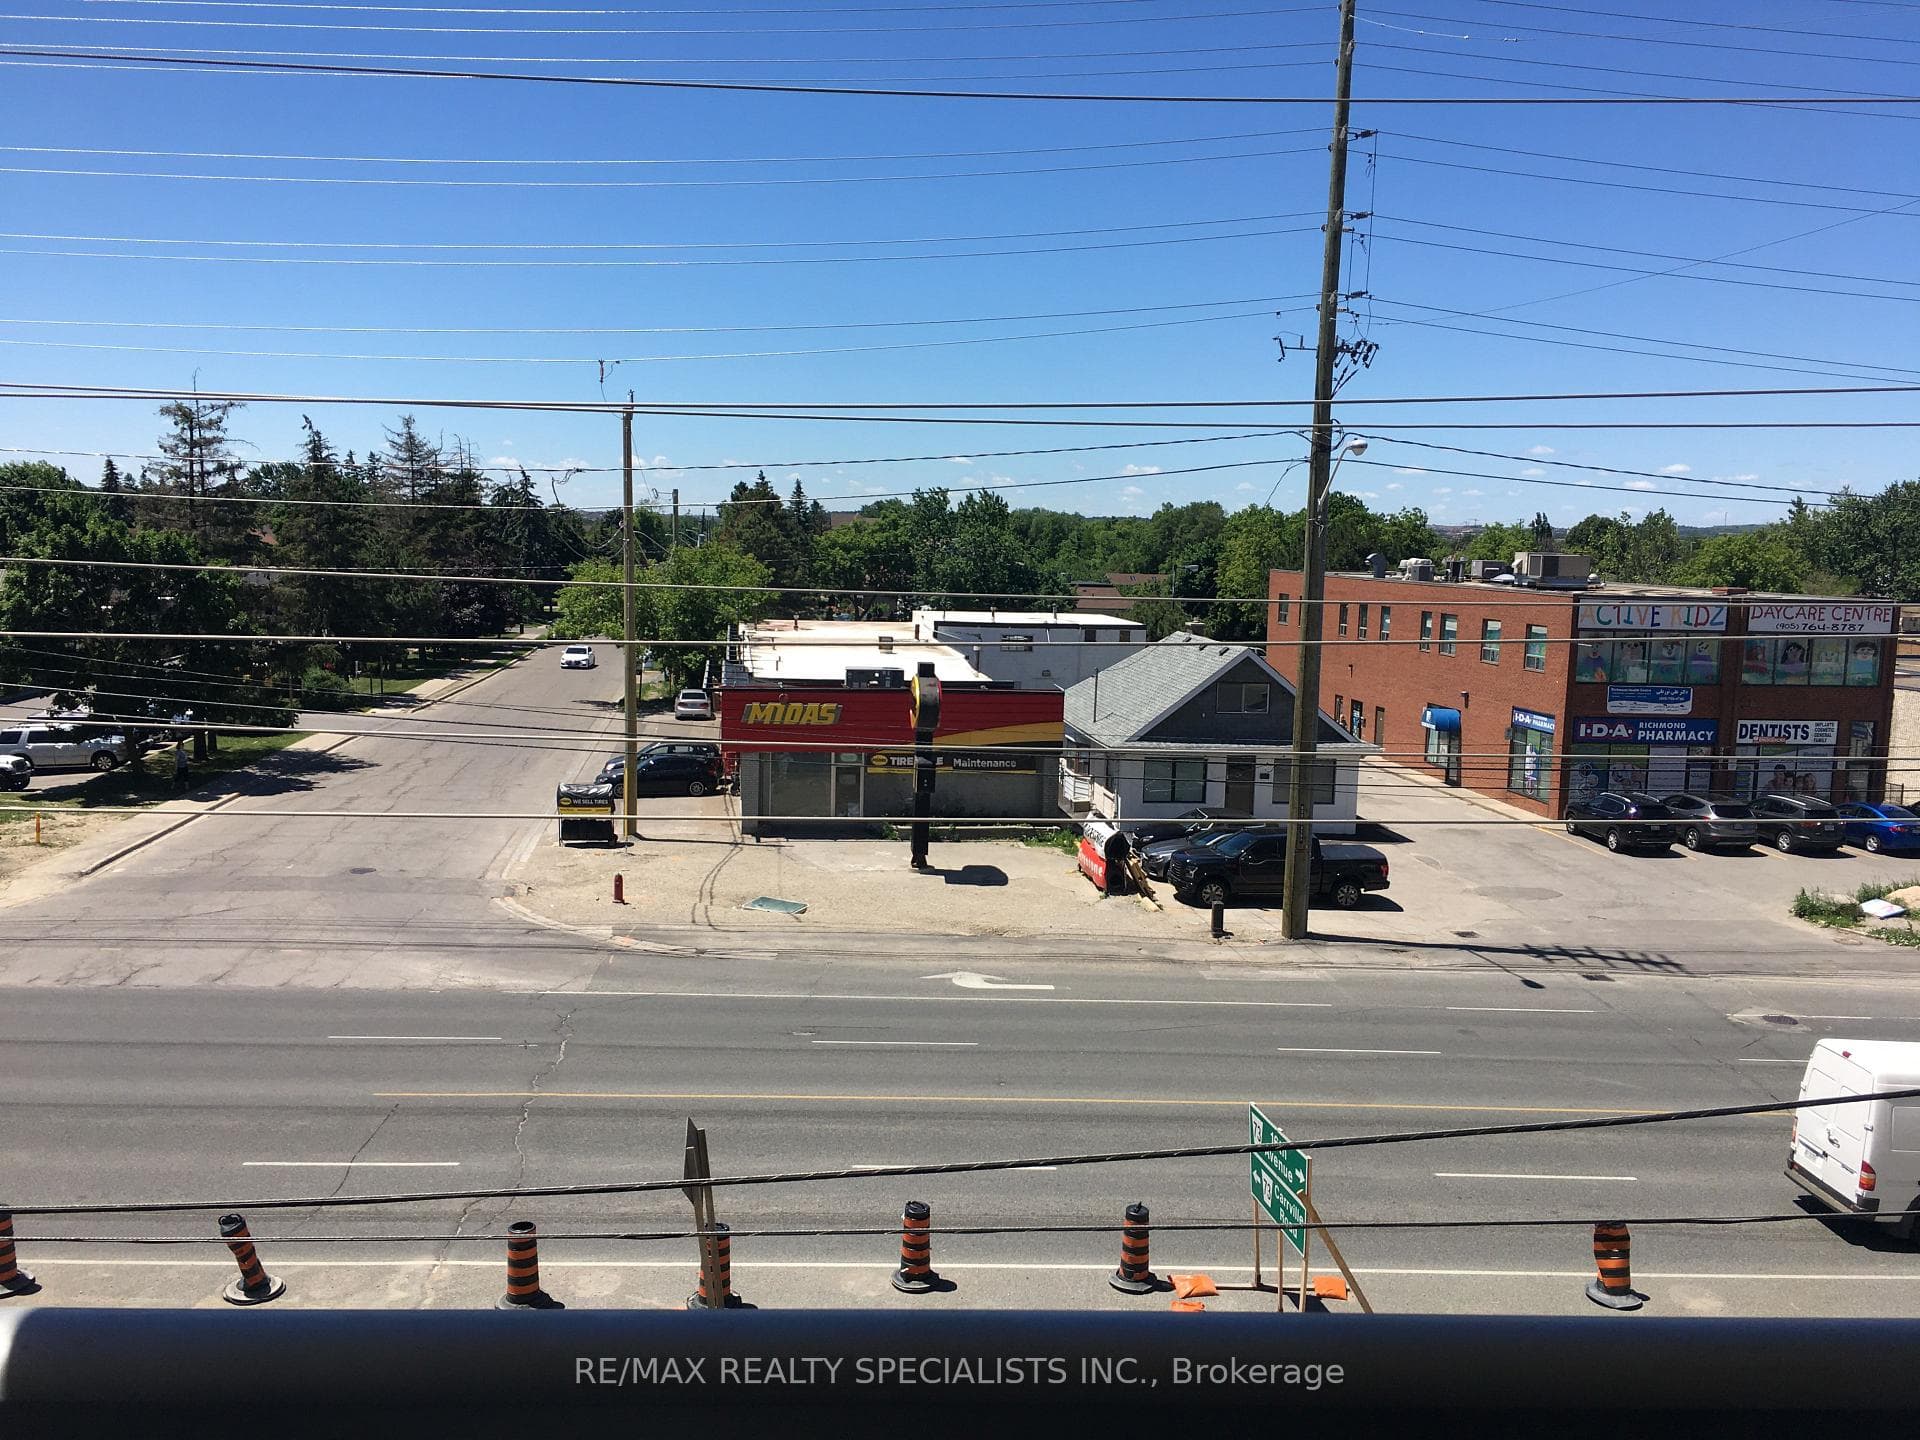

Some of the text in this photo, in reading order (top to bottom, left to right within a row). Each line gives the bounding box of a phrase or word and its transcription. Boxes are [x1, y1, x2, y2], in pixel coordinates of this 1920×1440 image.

[1580, 602, 1725, 628] ACTIVE KIDZ
[1751, 605, 1892, 623] DAYCARE CENTRE
[1802, 623, 1865, 632] 764-8787
[747, 702, 838, 725] MIDAS
[1638, 730, 1714, 741] PHARMACY
[1739, 723, 1810, 741] DENTISTS
[953, 758, 1017, 768] Maintenance
[1265, 1149, 1293, 1183] Avenue
[1274, 1184, 1304, 1224] Carrville
